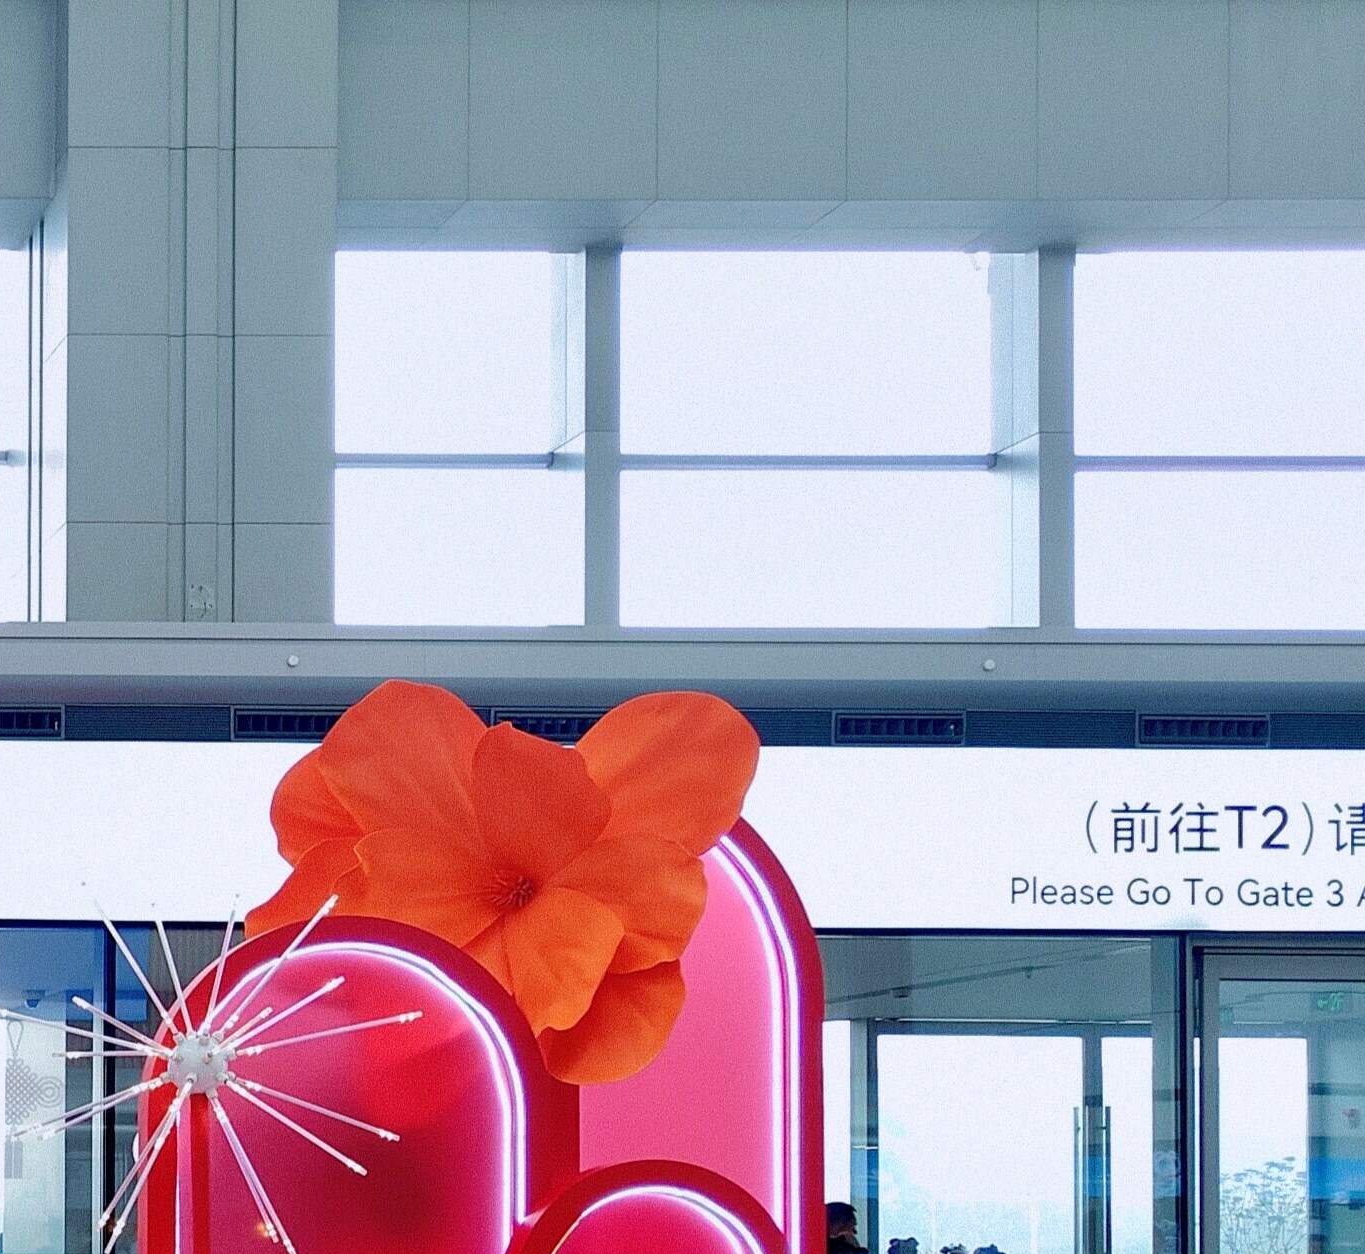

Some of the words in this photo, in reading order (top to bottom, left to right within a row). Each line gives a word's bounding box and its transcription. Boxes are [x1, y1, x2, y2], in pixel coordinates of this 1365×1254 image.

[1011, 877, 1114, 905] Please
[1127, 878, 1171, 906] Go
[1183, 878, 1224, 906] To
[1237, 879, 1314, 907] Gate
[1326, 880, 1345, 907] 3
